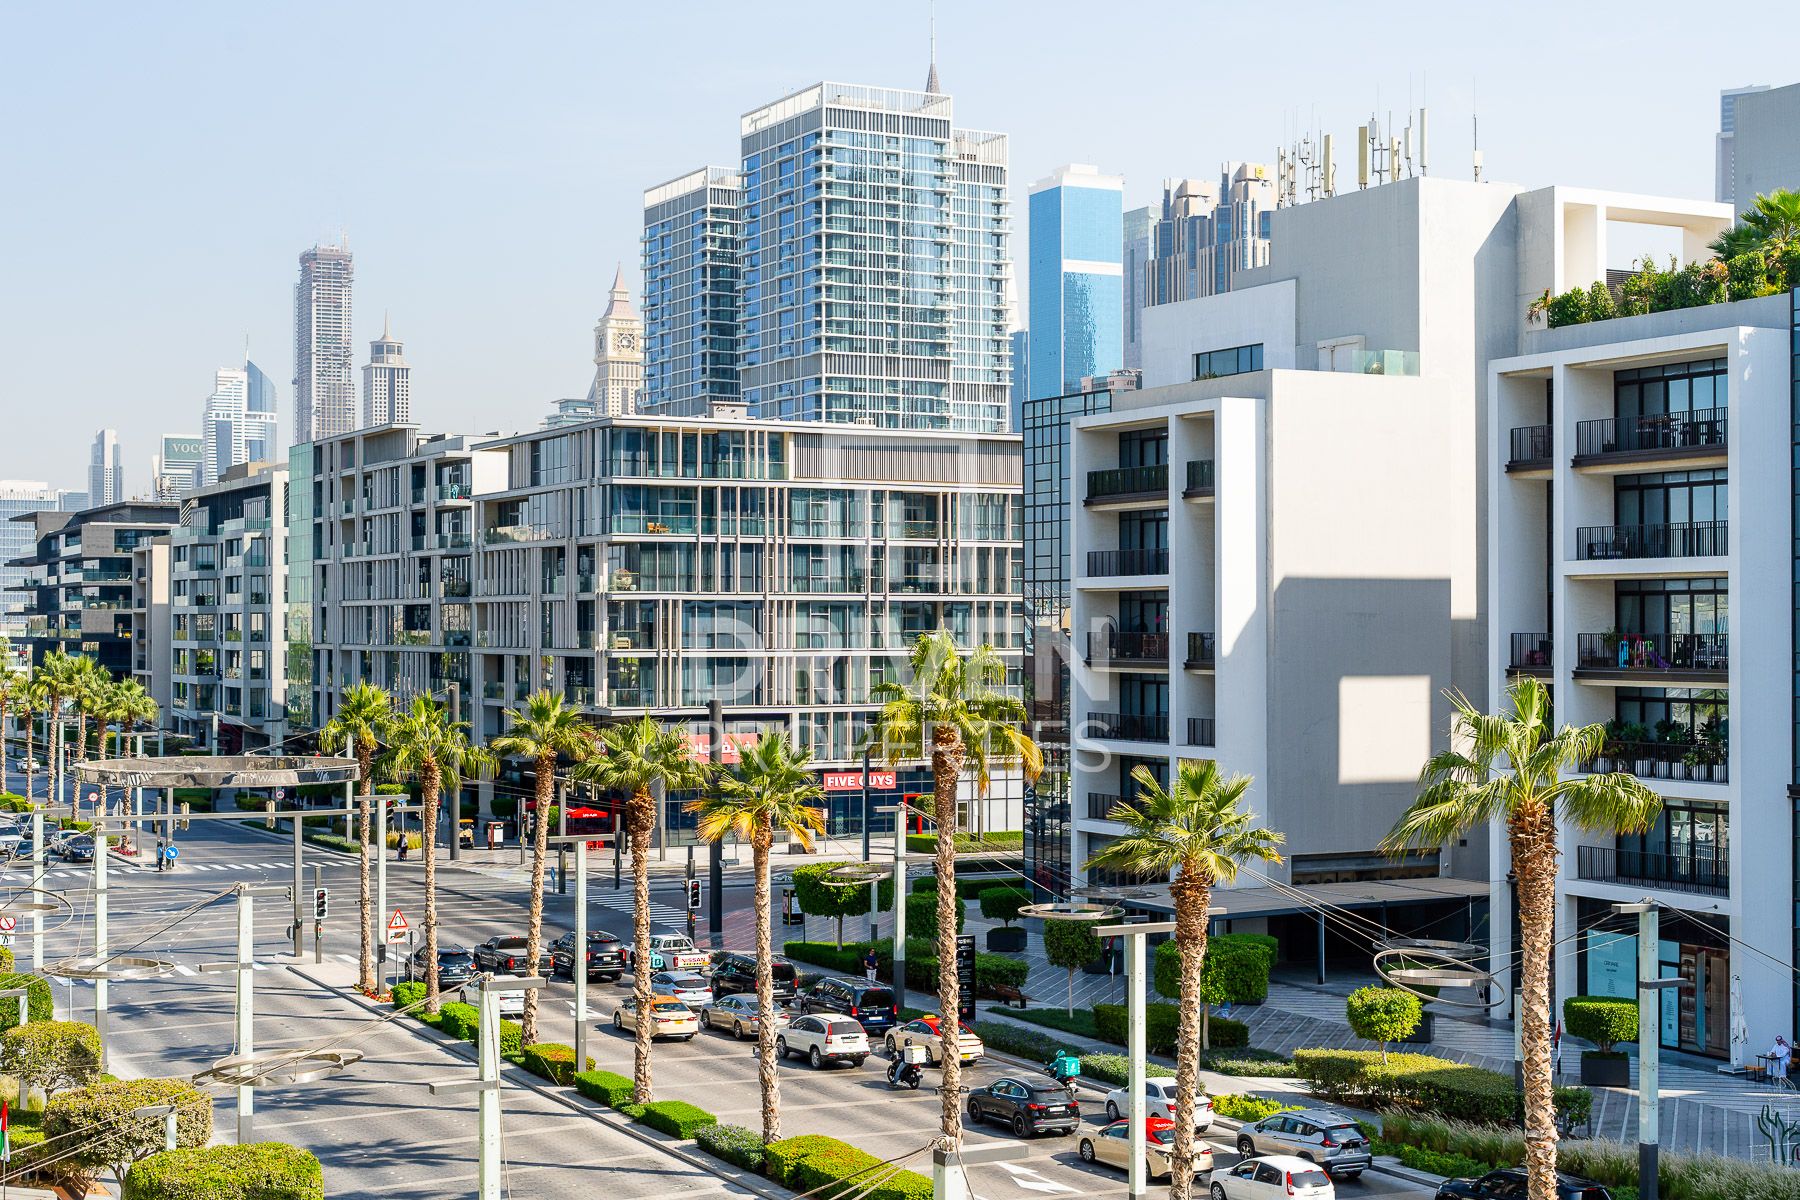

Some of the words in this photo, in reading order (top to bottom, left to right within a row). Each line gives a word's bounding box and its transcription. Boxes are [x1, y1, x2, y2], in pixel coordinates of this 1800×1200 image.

[232, 773, 256, 784] CITY
[258, 774, 287, 783] WALK
[827, 776, 856, 787] FIVE
